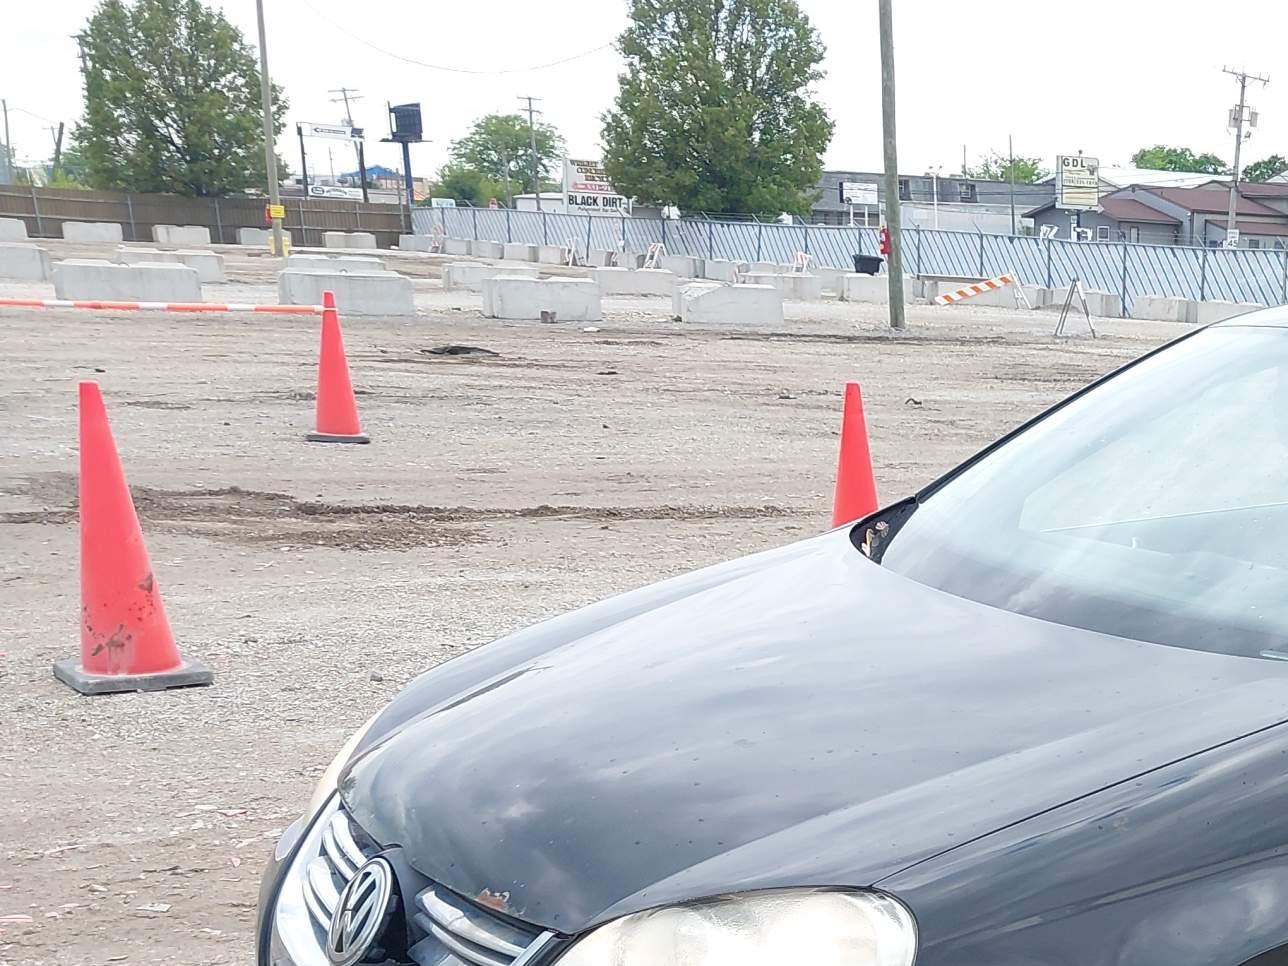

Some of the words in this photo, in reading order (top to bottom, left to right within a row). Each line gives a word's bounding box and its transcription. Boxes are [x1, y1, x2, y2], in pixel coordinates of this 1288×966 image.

[1063, 157, 1086, 169] GDL
[568, 195, 599, 207] BLACK
[602, 196, 623, 208] DIRT
